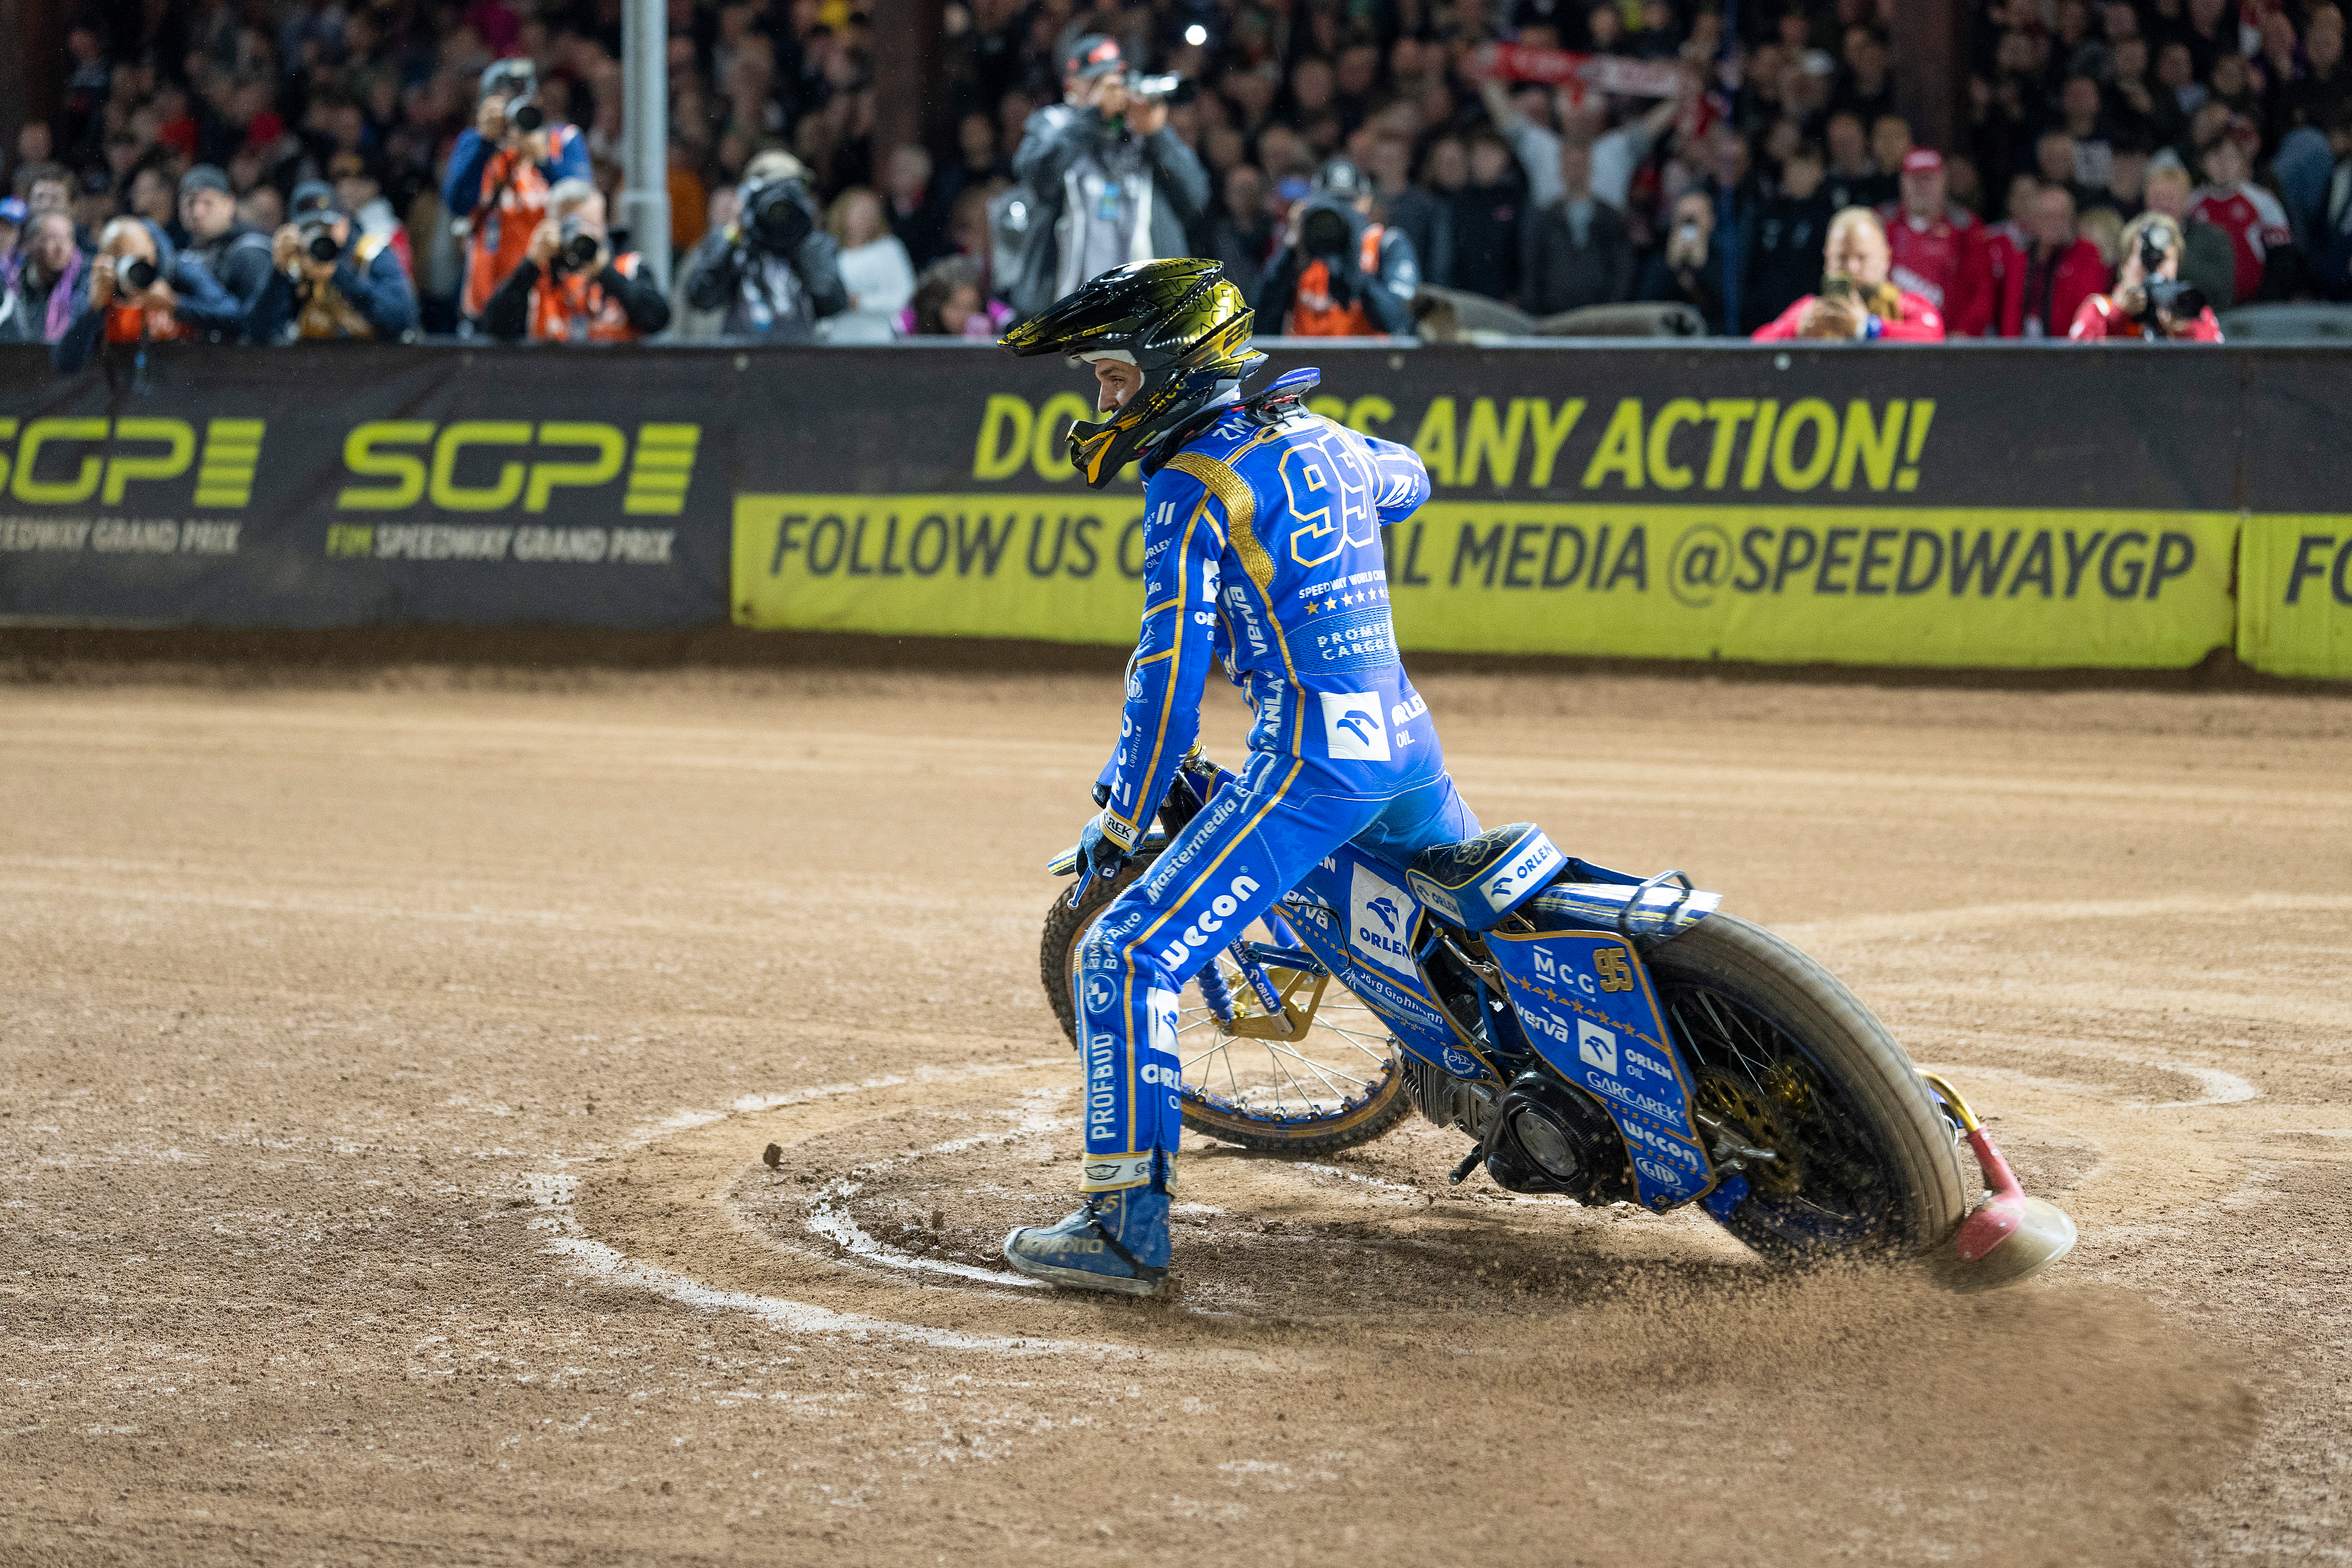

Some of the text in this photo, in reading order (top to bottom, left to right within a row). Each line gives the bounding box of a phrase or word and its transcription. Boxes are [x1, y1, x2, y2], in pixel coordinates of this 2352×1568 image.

[1211, 417, 1256, 440] ZM
[1412, 395, 1586, 488] ANY
[1583, 396, 1937, 492] ACTION!
[0, 418, 196, 506] GP
[375, 524, 515, 560] SPEEDWAY
[513, 525, 607, 561] GRAND
[608, 527, 675, 562] PRIX
[771, 512, 1019, 579] FOLLOW
[1027, 512, 1103, 579] US
[1450, 522, 1648, 591] MEDIA
[1668, 523, 2197, 608] @SPEEDWAYGP
[1146, 559, 1159, 569] OIL
[1299, 576, 1347, 599] SPEEDWAY
[1348, 571, 1373, 586] WORLD
[1391, 692, 1428, 727] ORLE
[1396, 730, 1416, 748] OIL
[1107, 816, 1132, 838] REK
[1147, 798, 1238, 905] Mastermedia
[1517, 842, 1553, 878] ORLEN
[1160, 876, 1261, 972] wecon
[1282, 890, 1328, 930] erva
[1359, 926, 1411, 961] ORLEN
[1361, 972, 1383, 993] Jörg
[1533, 951, 1595, 994] MCG
[1593, 947, 1635, 993] 95
[1256, 983, 1276, 1009] ORLEN
[1514, 1000, 1569, 1043] verva
[1141, 1064, 1180, 1092] ORL
[1625, 1049, 1673, 1081] ORLEN
[1092, 1032, 1116, 1140] PROFBUD
[1586, 1071, 1680, 1125] GARCAREK
[1622, 1118, 1699, 1170] wecon
